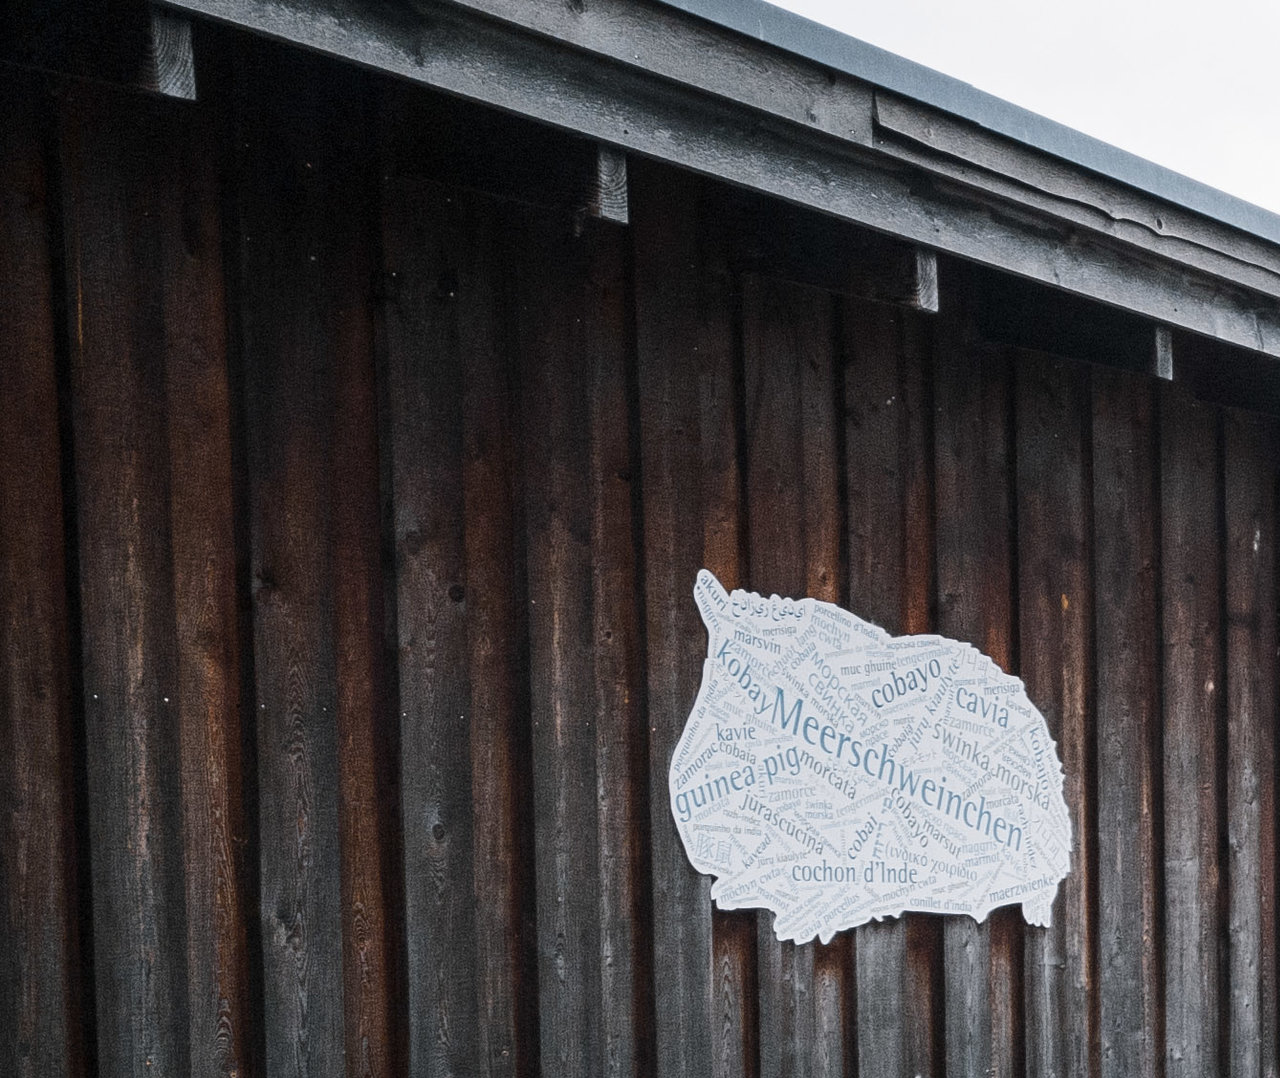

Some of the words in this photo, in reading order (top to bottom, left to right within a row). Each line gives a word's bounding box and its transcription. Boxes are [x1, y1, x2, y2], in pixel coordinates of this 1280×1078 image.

[701, 575, 728, 612] akuri
[734, 629, 782, 655] marsvin
[717, 638, 774, 715] kobay
[811, 652, 868, 727] морская
[871, 657, 941, 709] cobayo
[808, 673, 855, 734] свинка
[956, 687, 1009, 729] cavia
[715, 721, 757, 742] kavie
[719, 741, 758, 766] cobaia
[673, 742, 720, 791] zamorac
[675, 765, 757, 824] guinea
[763, 744, 801, 786] pig
[771, 685, 1023, 852] Meerschweinchen
[995, 763, 1051, 812] morska
[847, 811, 879, 860] cobai
[891, 786, 930, 849] cobayo
[922, 818, 962, 860] marsut
[792, 859, 856, 882] cochon
[863, 860, 918, 884] d'Inde
[988, 873, 1055, 903] maerzwienke
